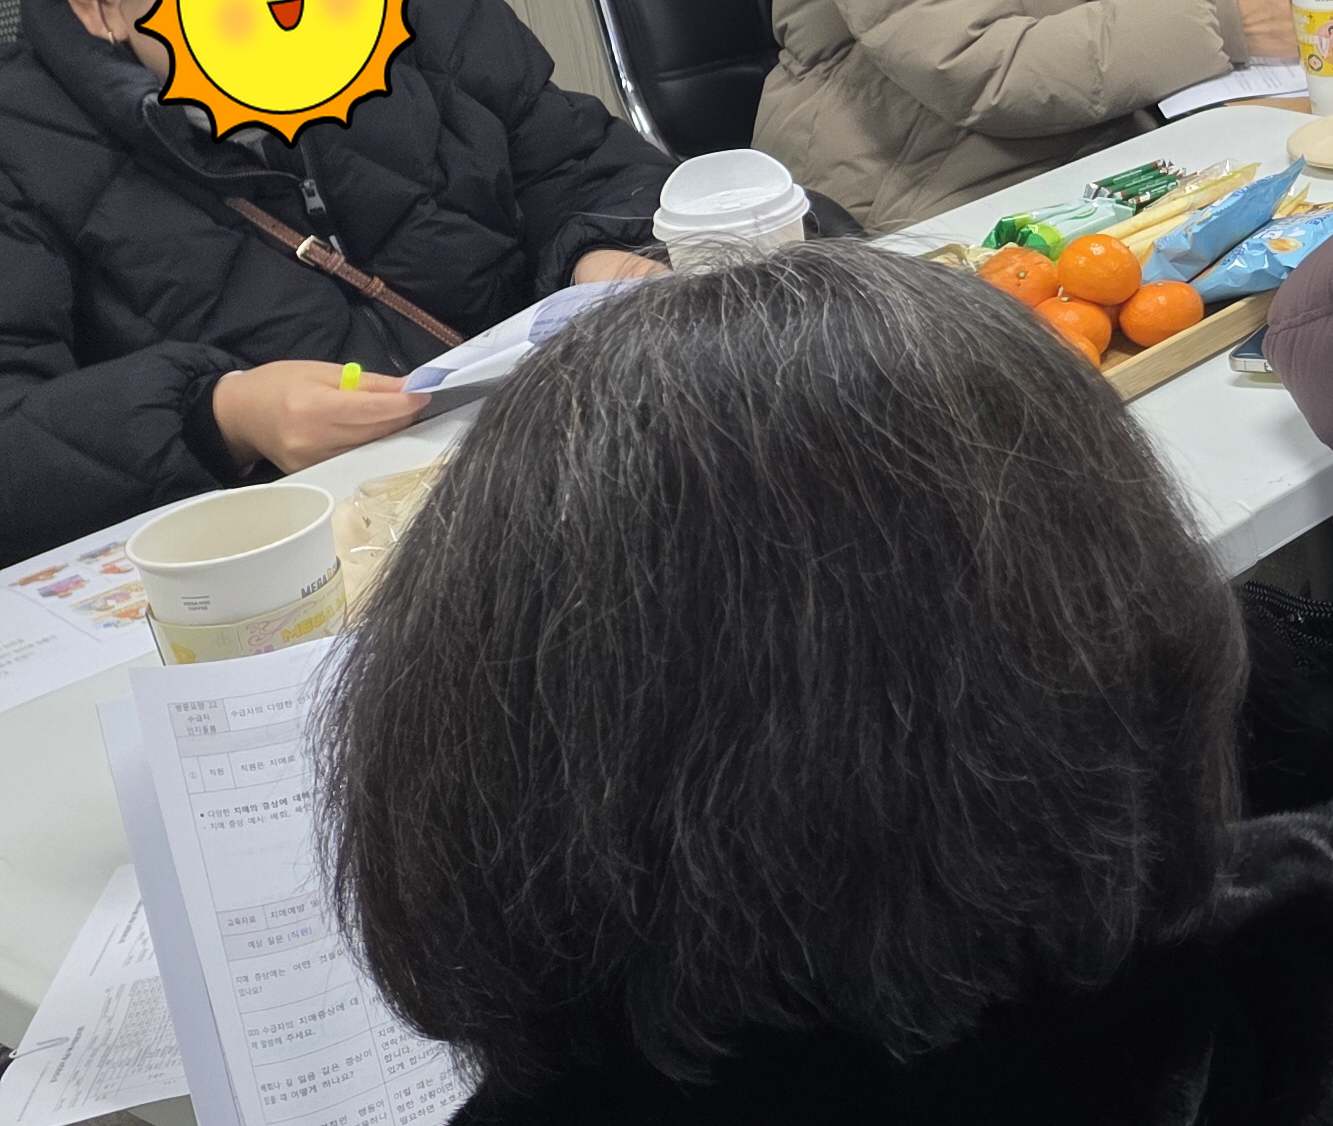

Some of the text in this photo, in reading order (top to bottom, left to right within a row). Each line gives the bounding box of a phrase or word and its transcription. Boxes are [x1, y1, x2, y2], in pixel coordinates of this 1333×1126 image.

[280, 605, 335, 643] MEGA
[267, 700, 293, 711] 다양한
[241, 762, 265, 772] 직원은
[234, 804, 258, 814] 치매의
[262, 797, 288, 810] 증상에
[229, 819, 244, 828] 증상
[270, 903, 305, 919] 치매예방
[247, 939, 263, 949] 예상
[293, 960, 311, 971] 어떤
[262, 1020, 295, 1034] 수급자의
[299, 1002, 345, 1025] 치매증상에
[345, 1049, 373, 1066] 증상이
[321, 1071, 354, 1088] 하나요?
